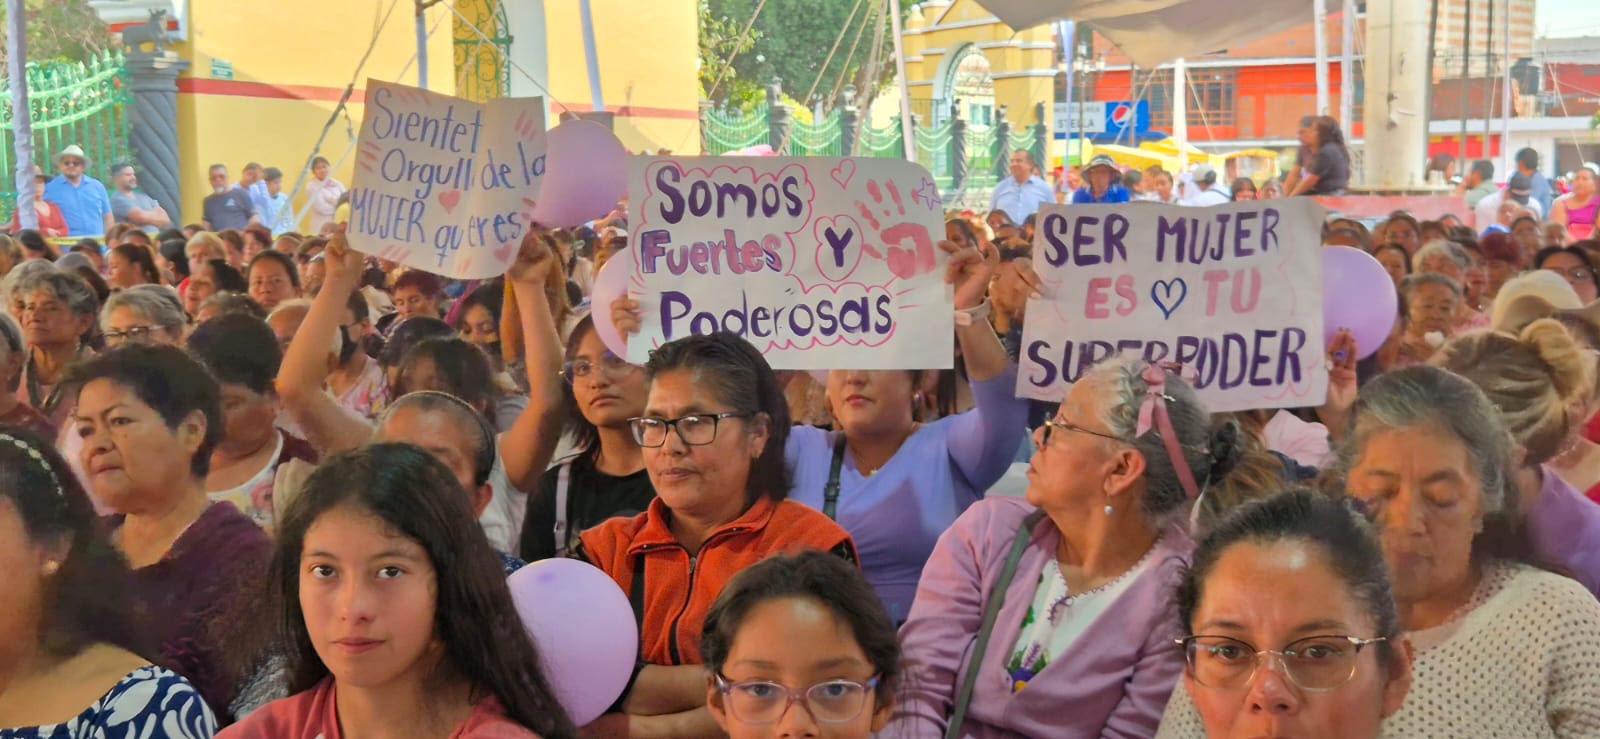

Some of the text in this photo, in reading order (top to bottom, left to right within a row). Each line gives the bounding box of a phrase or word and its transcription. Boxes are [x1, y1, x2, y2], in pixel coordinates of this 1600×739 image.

[373, 87, 482, 154] Sientet
[381, 141, 546, 199] Orgull de la
[656, 165, 802, 224] Somos
[351, 188, 425, 243] MUJER
[1043, 208, 1280, 268] SER MUJER
[641, 227, 854, 275] Fuertes Y
[660, 288, 892, 340] Poderosas
[1084, 267, 1262, 319] ES TU
